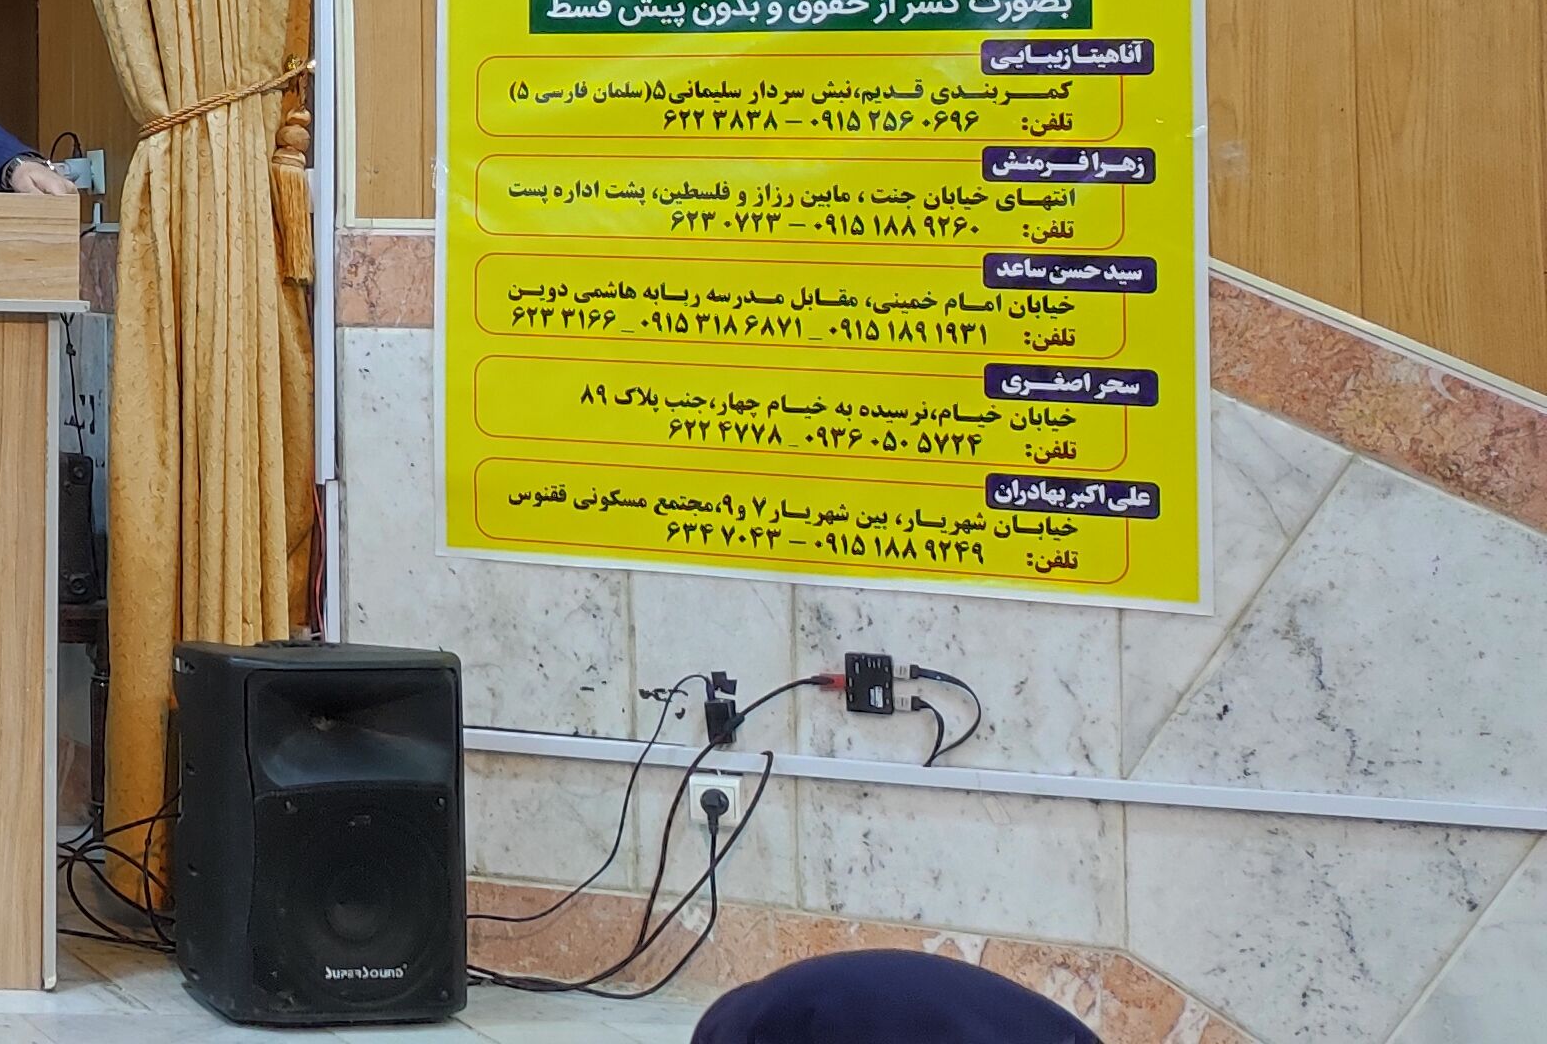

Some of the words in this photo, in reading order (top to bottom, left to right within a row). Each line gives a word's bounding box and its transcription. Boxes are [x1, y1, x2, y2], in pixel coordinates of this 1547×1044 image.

[766, 1, 782, 25] و
[990, 44, 1071, 70] زیبایی
[1072, 41, 1144, 68] آناهیتا
[535, 81, 588, 103] فارسی
[748, 80, 804, 105] سردار
[664, 109, 704, 130] ۶۲۲
[713, 110, 778, 131] ۳۸۳۸
[810, 110, 860, 131] ۰۹۱۵
[868, 110, 914, 131] ۲۵۶
[922, 110, 979, 132] ۰۶۹۶
[1022, 112, 1073, 137] تلفن:
[992, 150, 1089, 177] فرمنش
[1092, 152, 1144, 178] زهرا
[509, 183, 548, 204] پست
[554, 180, 599, 203] اداره
[605, 181, 646, 206] پشت
[736, 191, 747, 207] و
[753, 183, 794, 208] رزاز
[801, 185, 850, 208] مابین
[871, 189, 916, 209] جنت
[923, 186, 988, 210] خیابان
[996, 188, 1075, 212] انتهای
[671, 211, 716, 231] ۶۲۳
[724, 212, 781, 233] ۰۷۲۳
[814, 214, 864, 235] ۰۹۱۵
[874, 215, 916, 237] ۱۸۸
[924, 216, 979, 238] ۹۲۶۰
[1023, 220, 1074, 244] تلفن:
[997, 258, 1046, 277] ساعد
[1049, 265, 1101, 284] حسن
[1104, 265, 1142, 285] سید
[574, 281, 637, 303] هاشمی
[706, 288, 784, 309] مدرسه
[791, 287, 858, 311] مقابل
[945, 292, 1002, 316] امام
[1009, 294, 1075, 319] خیابان
[512, 306, 554, 328] ۶۲۳
[561, 308, 616, 330] ۳۱۶۶
[641, 311, 688, 333] ۰۹۱۵
[695, 313, 737, 335] ۳۱۸
[745, 315, 801, 338] ۶۸۷۱
[829, 318, 879, 341] ۰۹۱۵
[888, 321, 927, 343] ۱۸۹
[936, 322, 986, 345] ۱۹۳۱
[1024, 328, 1075, 352] تلفن:
[581, 384, 607, 405] ۸۹
[1002, 372, 1091, 396] اصغری
[1094, 379, 1140, 399] سحر
[615, 387, 659, 413] پلاک
[767, 395, 827, 418] خیام
[835, 402, 852, 416] به
[669, 419, 710, 441] ۶۲۲
[1010, 406, 1076, 432] خیابان
[805, 426, 862, 449] ۰۹۳۶
[871, 430, 908, 451] ۰۵۰
[1025, 440, 1077, 464] تلفن:
[509, 484, 567, 507] ققنوس
[573, 488, 647, 512] مسکونی
[994, 479, 1066, 507] بهادران
[1066, 484, 1105, 509] اکبر
[1108, 486, 1150, 511] علی
[769, 499, 849, 526] شهریار
[856, 511, 888, 530] بین
[994, 514, 1078, 541] خیابان
[815, 533, 865, 556] ۰۹۱۵
[874, 536, 917, 559] ۱۸۸
[1027, 550, 1078, 574] تلفن:
